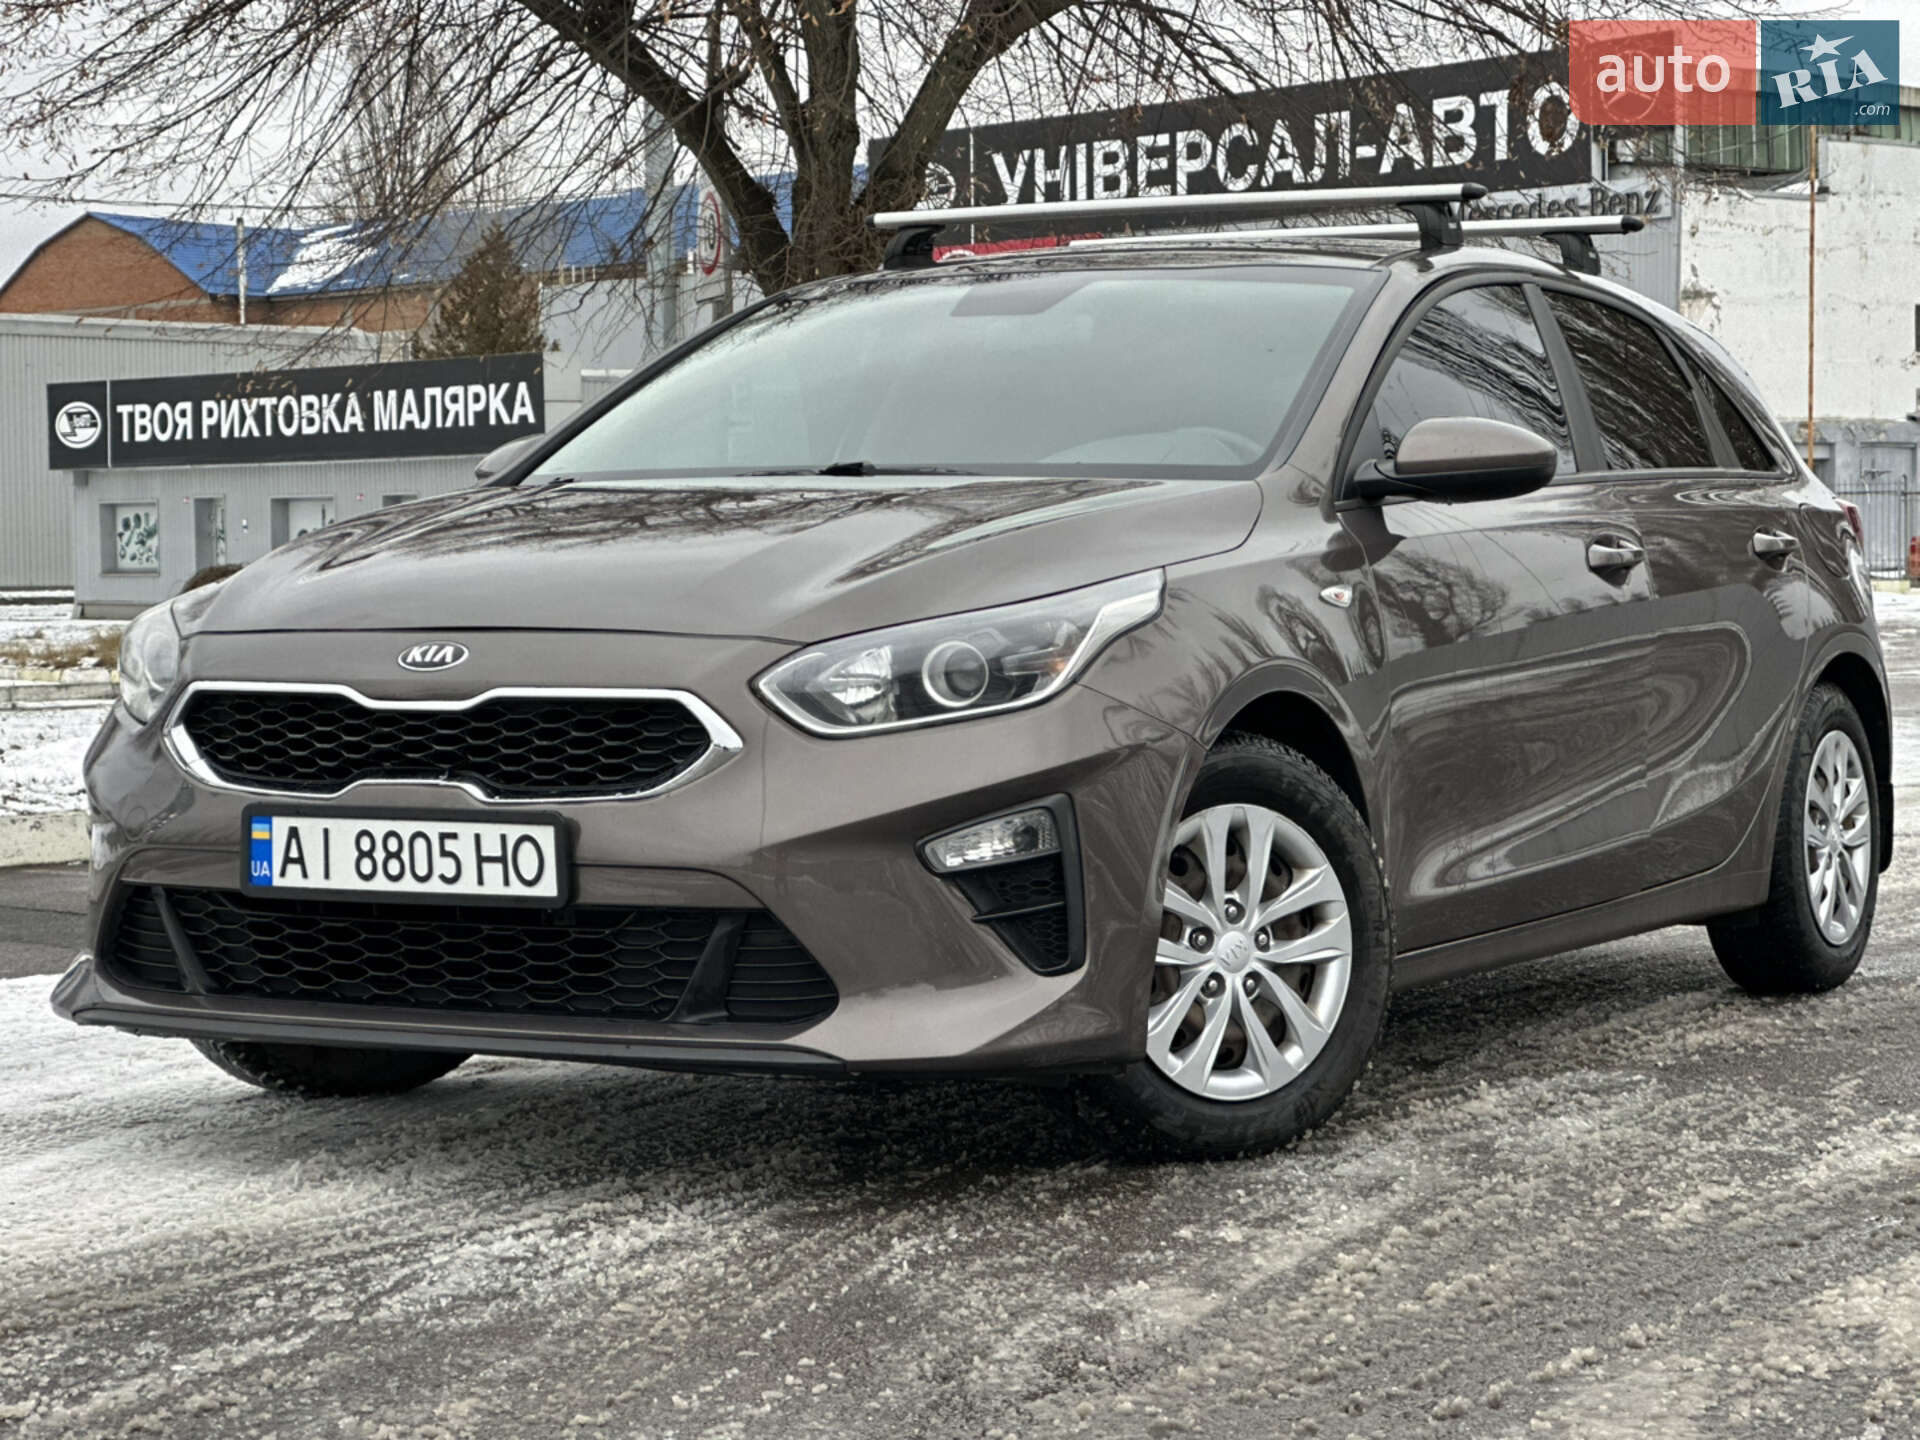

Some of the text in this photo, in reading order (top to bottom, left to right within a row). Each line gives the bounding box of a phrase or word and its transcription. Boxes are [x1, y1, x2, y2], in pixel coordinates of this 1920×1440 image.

[986, 81, 1580, 205] УНІВЕРСАЛ-АВТО
[1459, 184, 1663, 222] ercedes-Benz
[116, 381, 537, 443] ТВОЯ РИХТОВКА МАЛЯРКА
[406, 645, 454, 663] KIA
[251, 860, 270, 877] UA
[279, 826, 545, 887] AI 8805 HO
